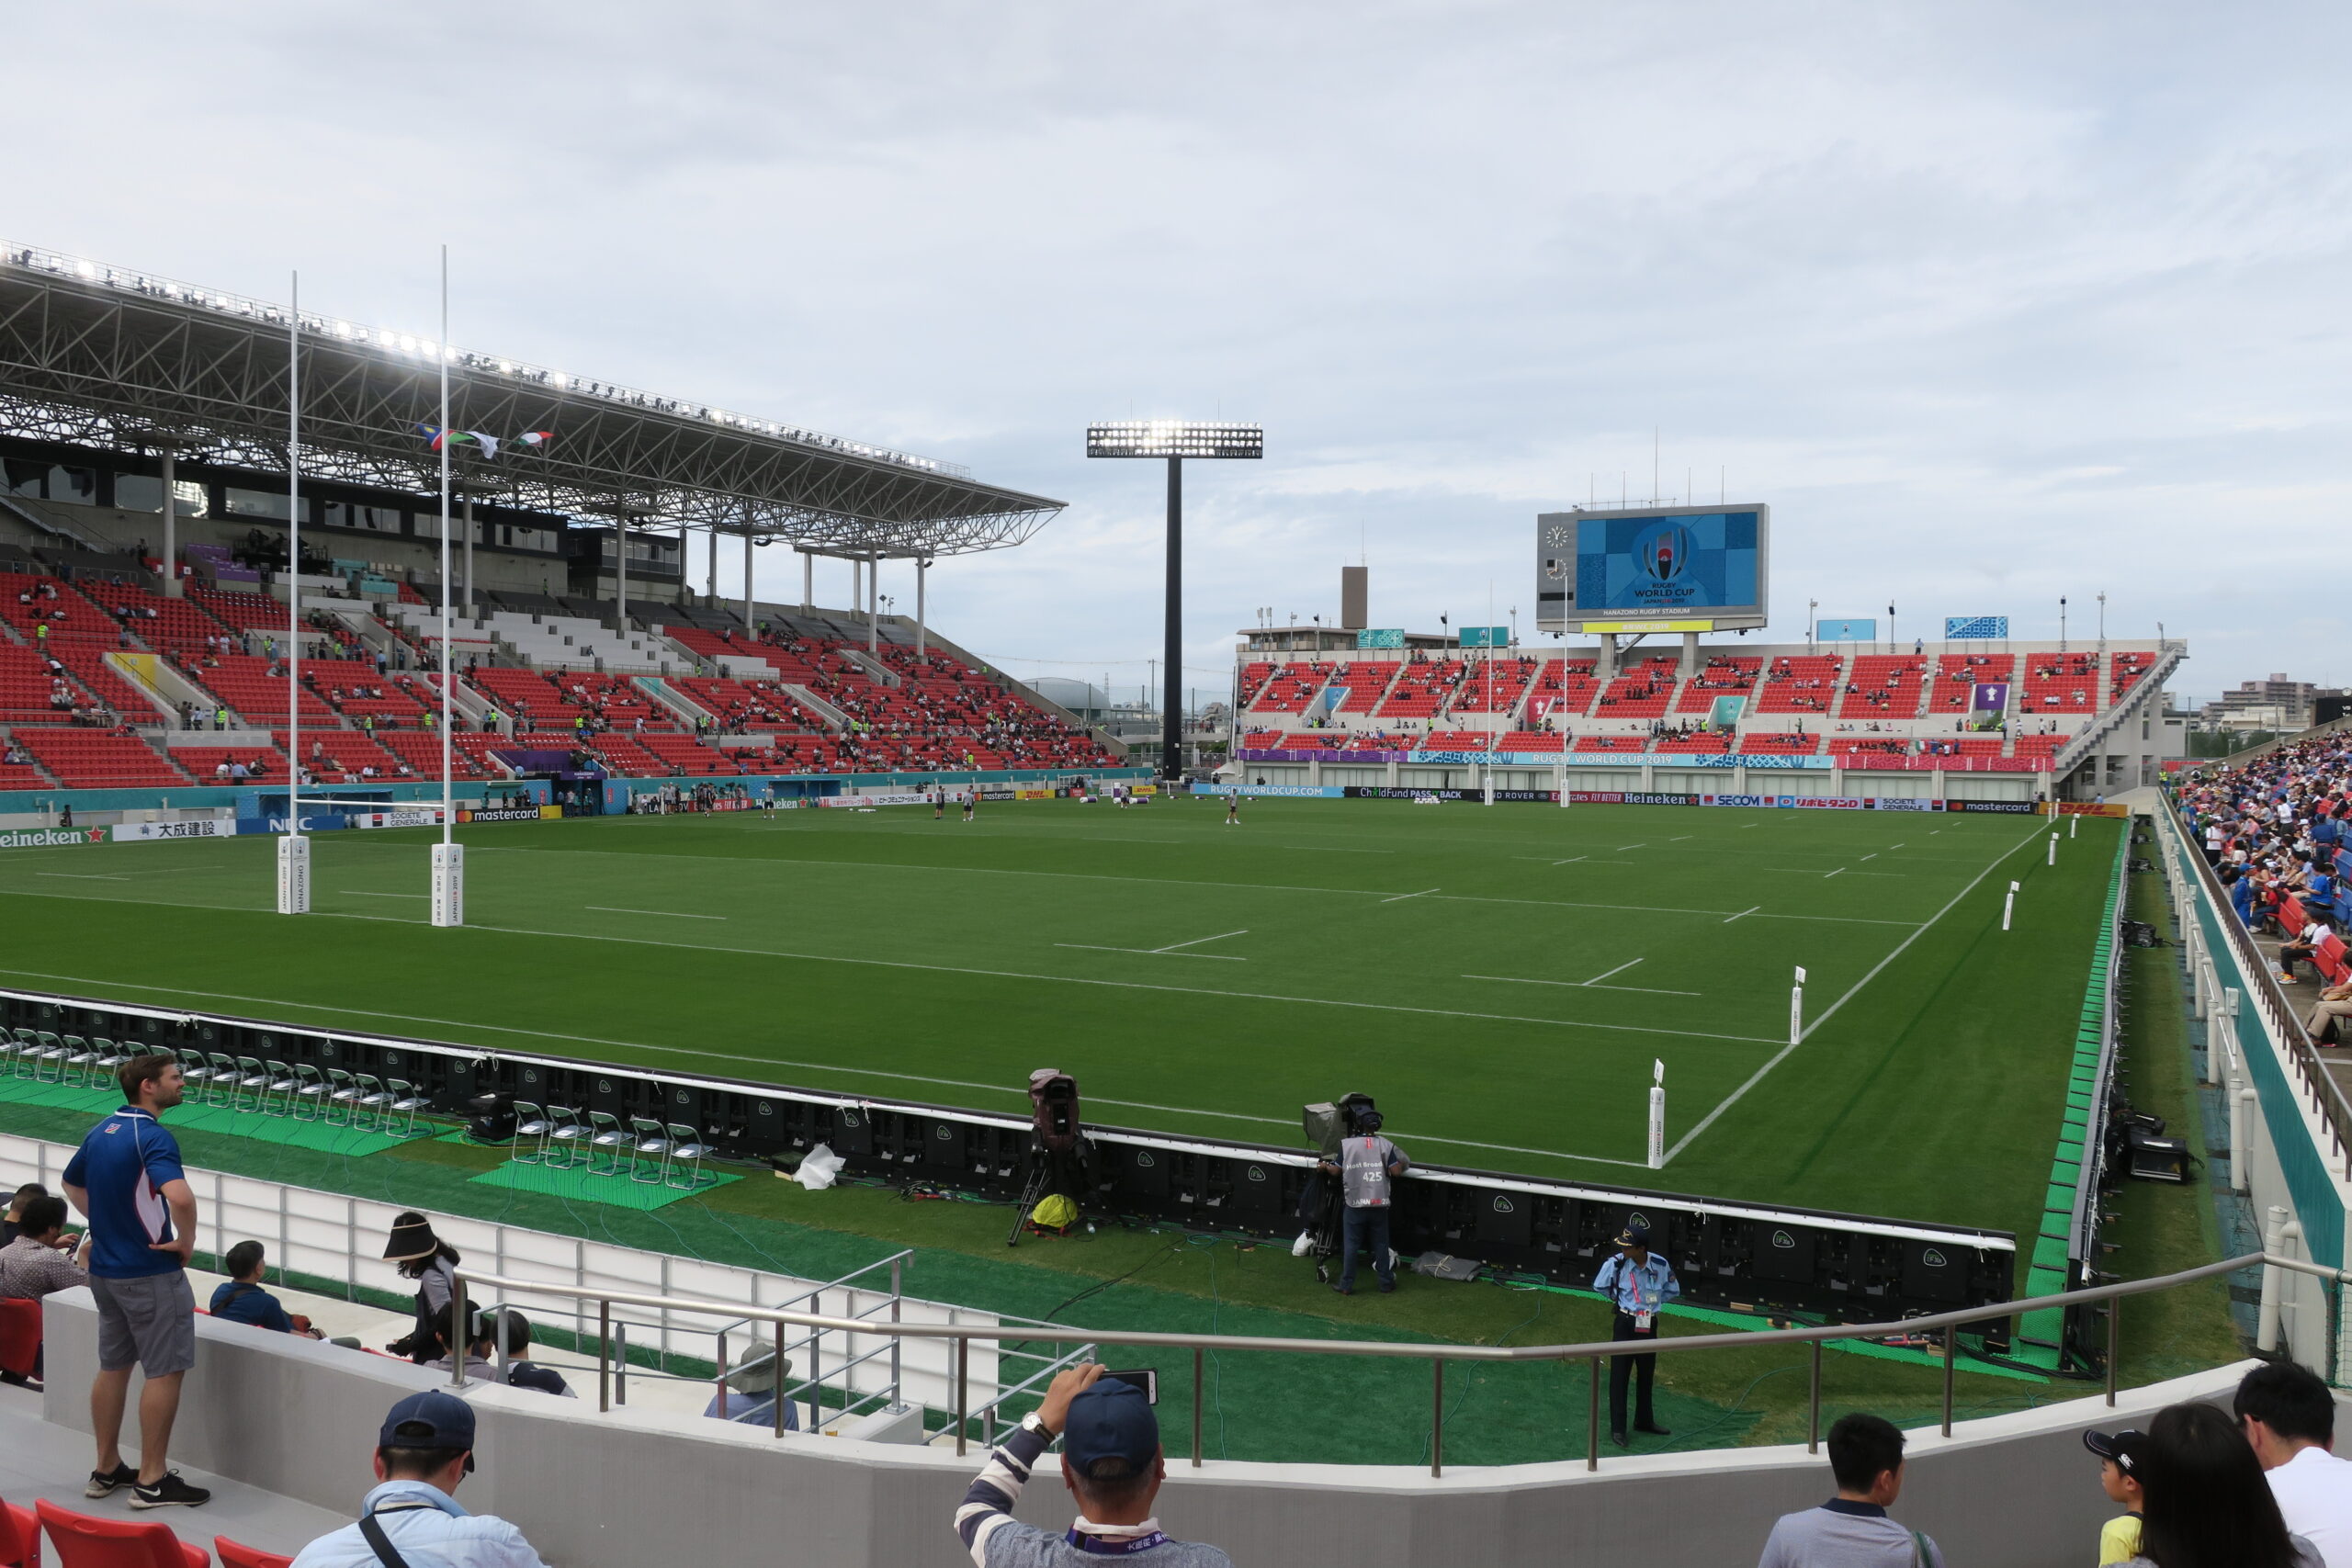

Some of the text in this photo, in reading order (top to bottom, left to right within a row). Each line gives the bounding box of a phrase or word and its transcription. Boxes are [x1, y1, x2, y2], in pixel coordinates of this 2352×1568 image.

[1634, 588, 1695, 597] WORLD CUP
[1532, 754, 1672, 764] RUGBY WORLD CUP 2019
[1591, 793, 1601, 801] FLY
[1601, 793, 1622, 802] BETTER
[1624, 793, 1687, 806] Heineken
[1718, 795, 1759, 807] SECOM
[1796, 798, 1858, 808] リポビタンD
[755, 798, 797, 809] Heneken
[1966, 802, 2031, 812] mastercard
[474, 807, 538, 821] mastercard
[2057, 803, 2105, 816] DHL
[158, 822, 216, 837] 大成建設
[269, 817, 313, 831] NEC
[1346, 1162, 1362, 1170] Host
[1363, 1171, 1383, 1182] 425
